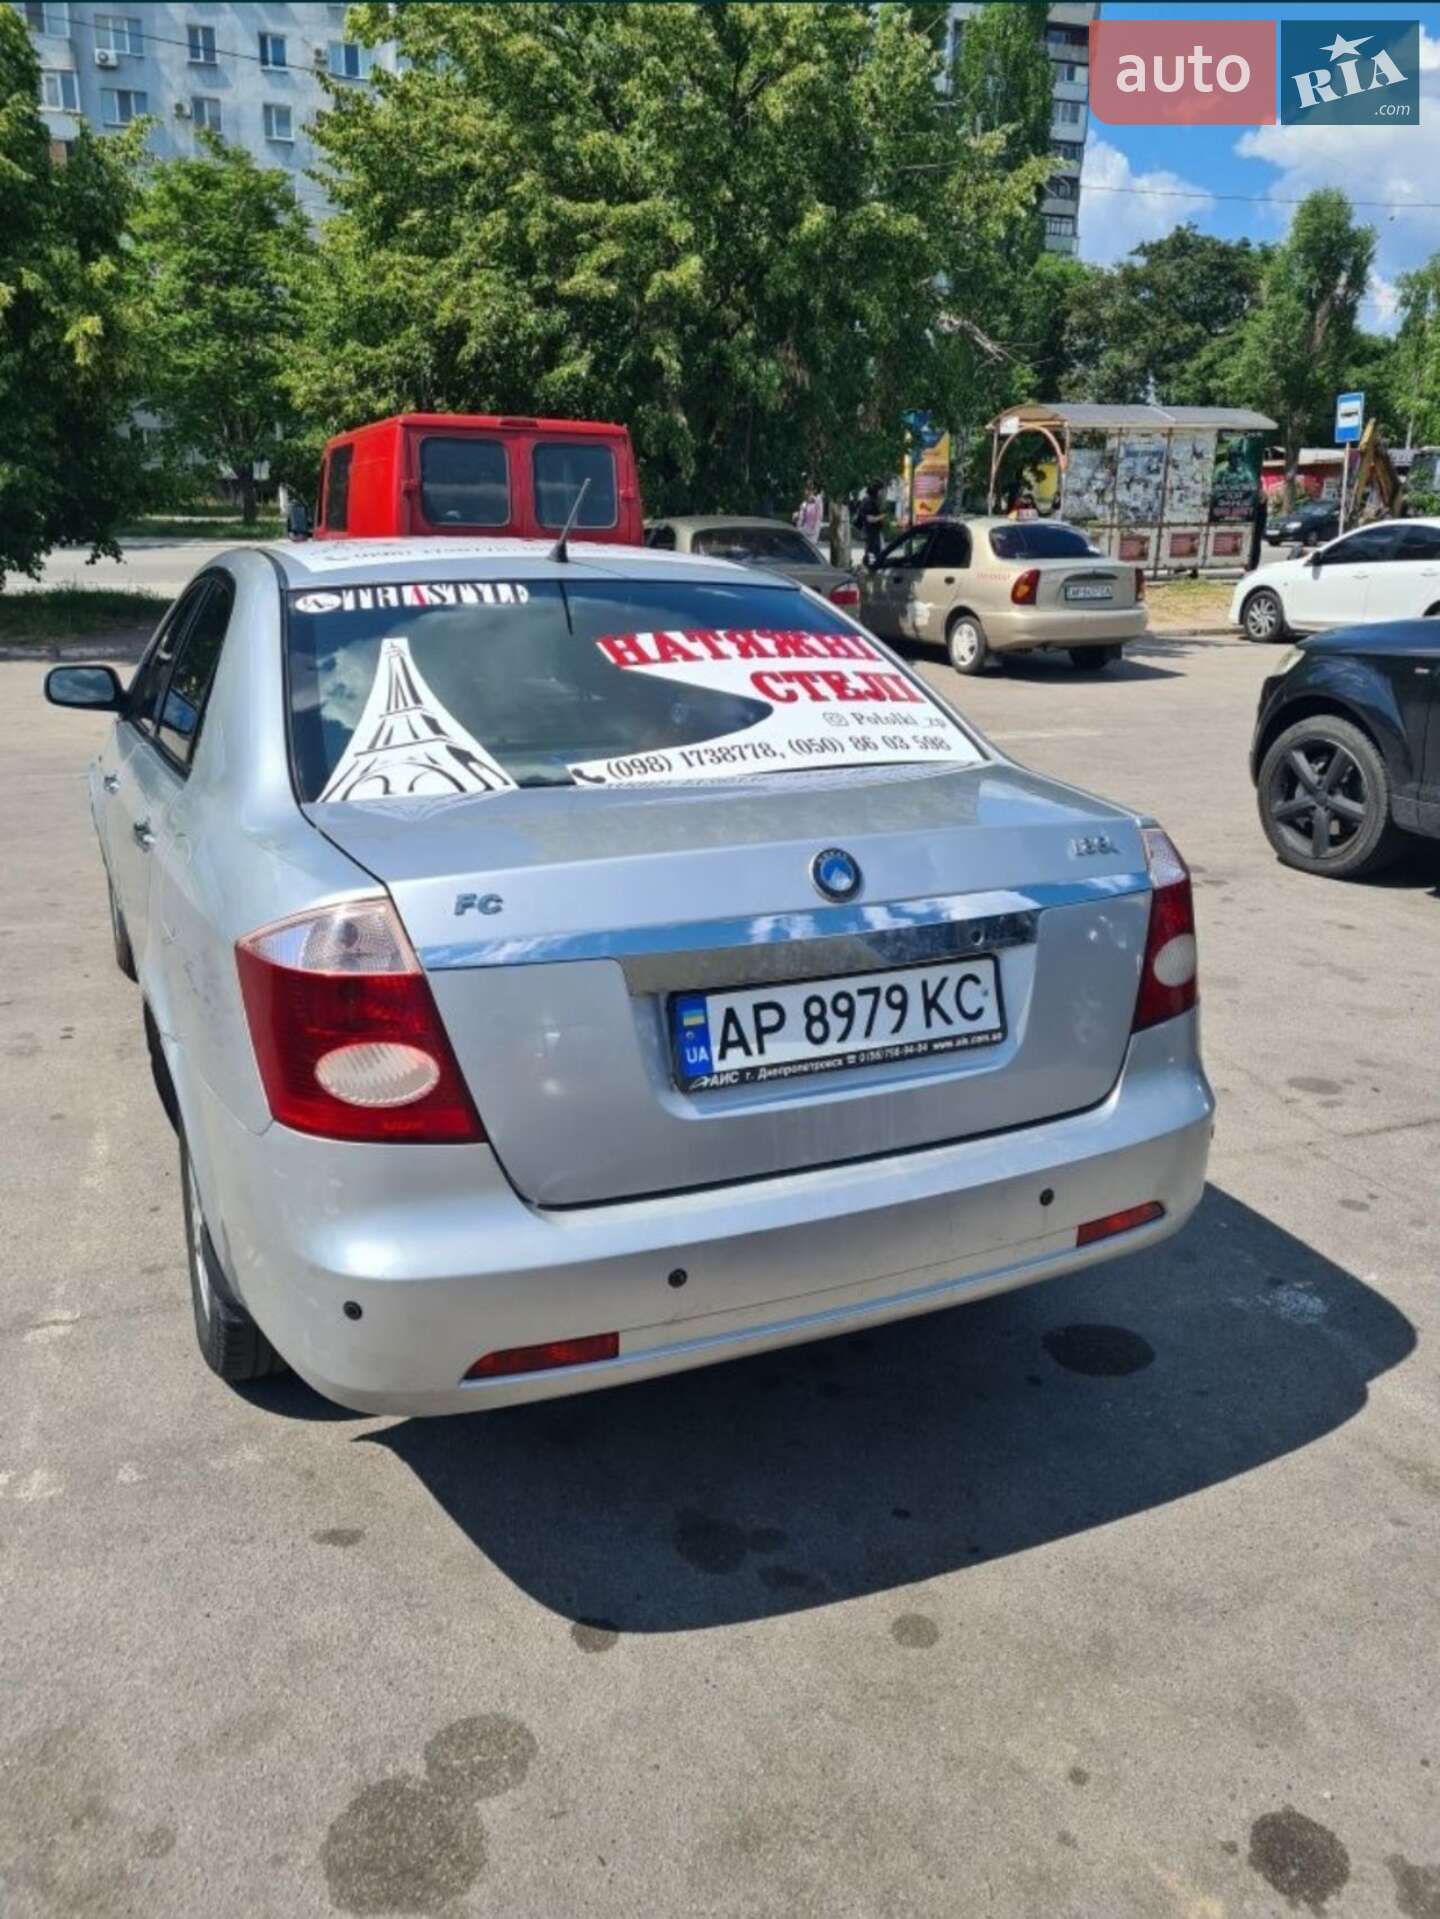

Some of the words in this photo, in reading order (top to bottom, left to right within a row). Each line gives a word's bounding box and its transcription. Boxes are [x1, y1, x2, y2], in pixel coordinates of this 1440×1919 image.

[597, 629, 884, 669] НАТЯЖНІ
[750, 670, 927, 703] СТЕЛІ
[606, 753, 673, 779] (098)
[788, 736, 845, 757] (050)
[848, 735, 879, 751] 86
[881, 735, 910, 750] 03
[454, 893, 504, 916] FC
[717, 1000, 786, 1060] AP
[803, 983, 909, 1046] 8979
[921, 973, 985, 1029] KC
[685, 1047, 710, 1064] UA
[710, 1071, 739, 1087] АИС
